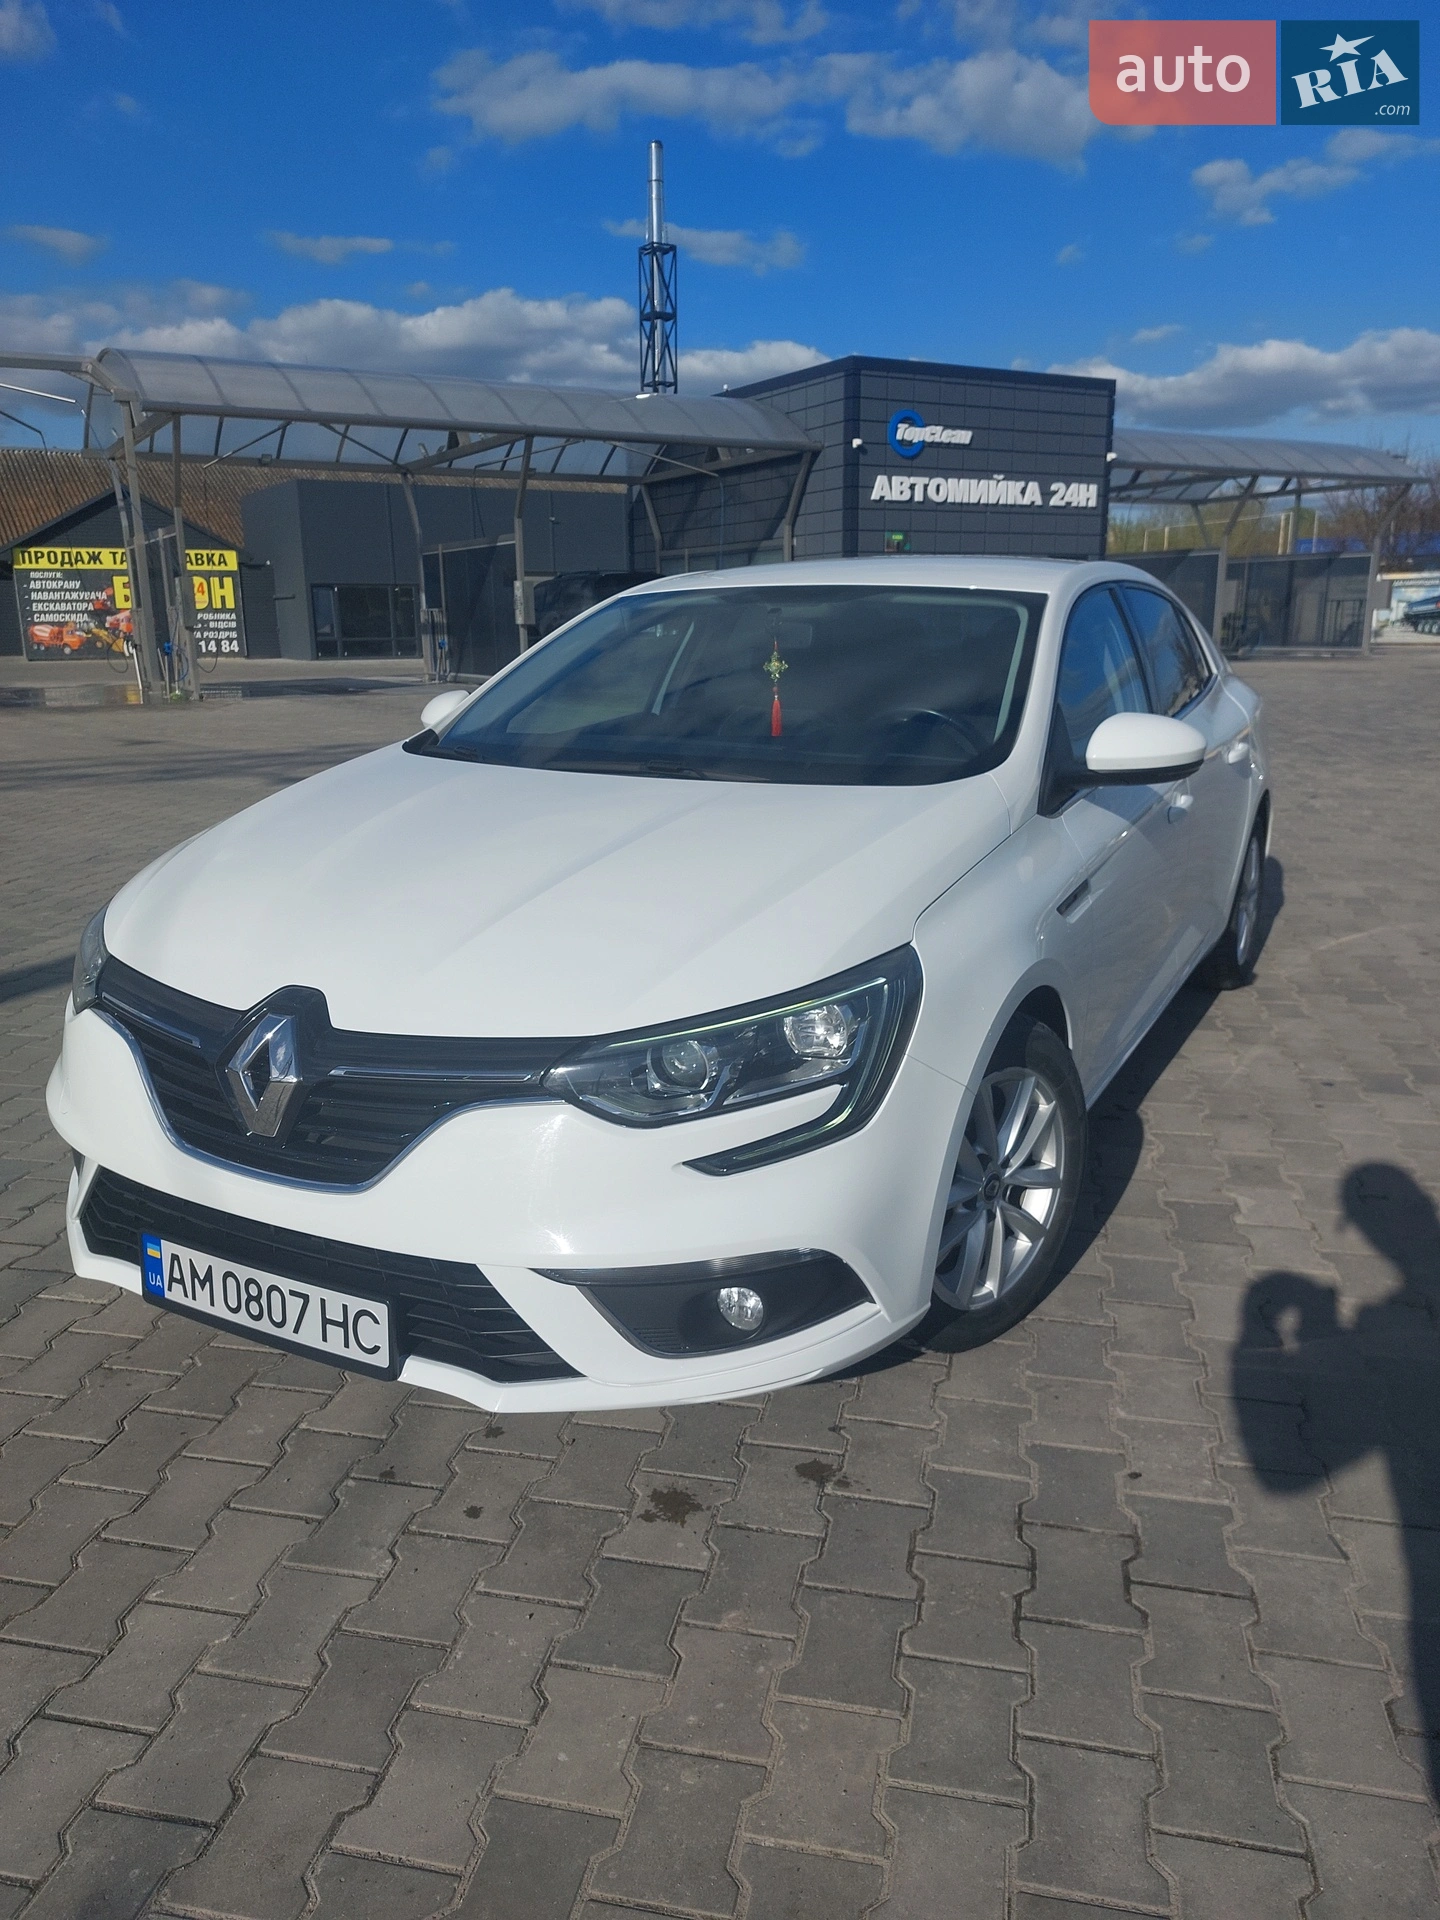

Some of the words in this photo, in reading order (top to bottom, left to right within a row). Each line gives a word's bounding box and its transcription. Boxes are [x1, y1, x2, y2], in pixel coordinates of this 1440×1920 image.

[895, 423, 973, 445] TopClean
[870, 474, 1043, 506] АВТОМИЙКА
[20, 550, 104, 567] ПРОДАЖ
[186, 553, 228, 567] АВКА
[29, 580, 81, 589] АВТОКРАНУ
[32, 602, 94, 611] ЕКСКАВАТОРА
[33, 613, 89, 622] САМОСКИДА
[198, 640, 217, 653] 14
[220, 640, 239, 653] 84
[148, 1271, 163, 1288] UA
